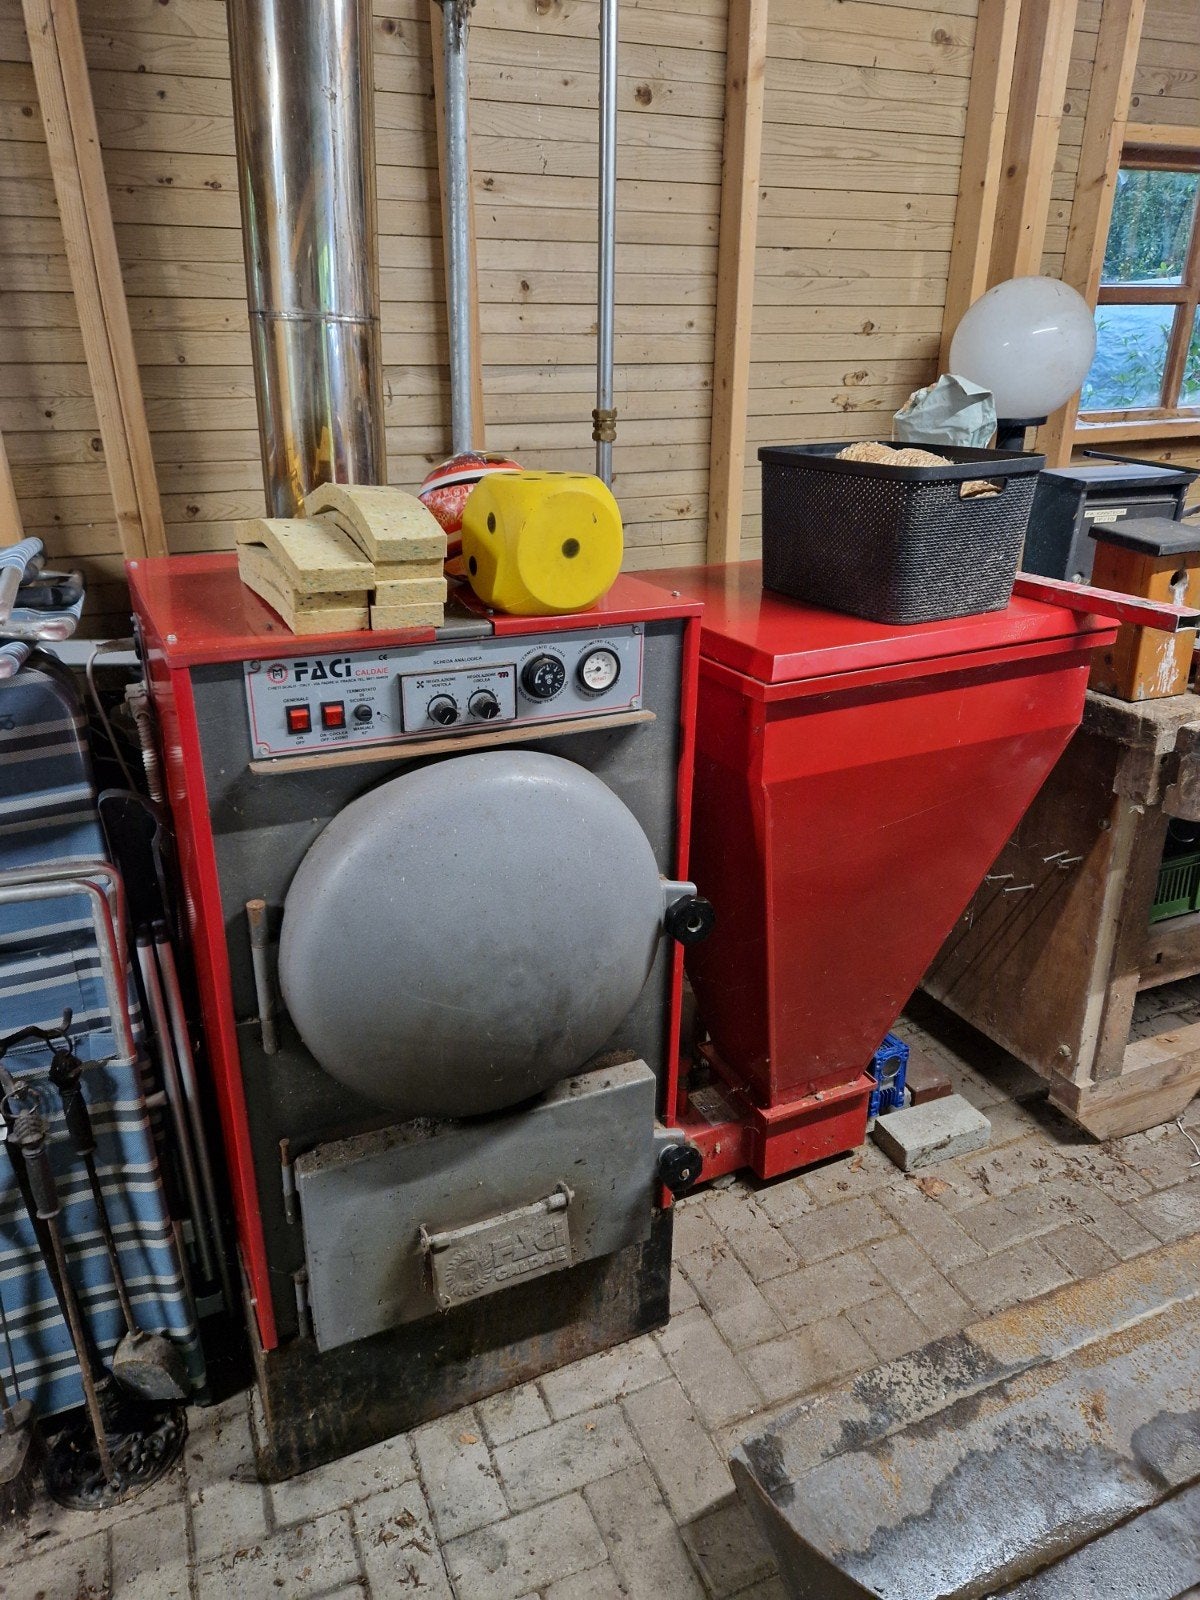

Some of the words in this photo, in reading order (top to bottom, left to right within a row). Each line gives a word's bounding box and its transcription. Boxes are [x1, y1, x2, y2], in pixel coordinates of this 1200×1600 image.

[378, 653, 388, 661] CE
[355, 667, 389, 677] CALDAIE
[346, 686, 377, 694] TERMOSTATO
